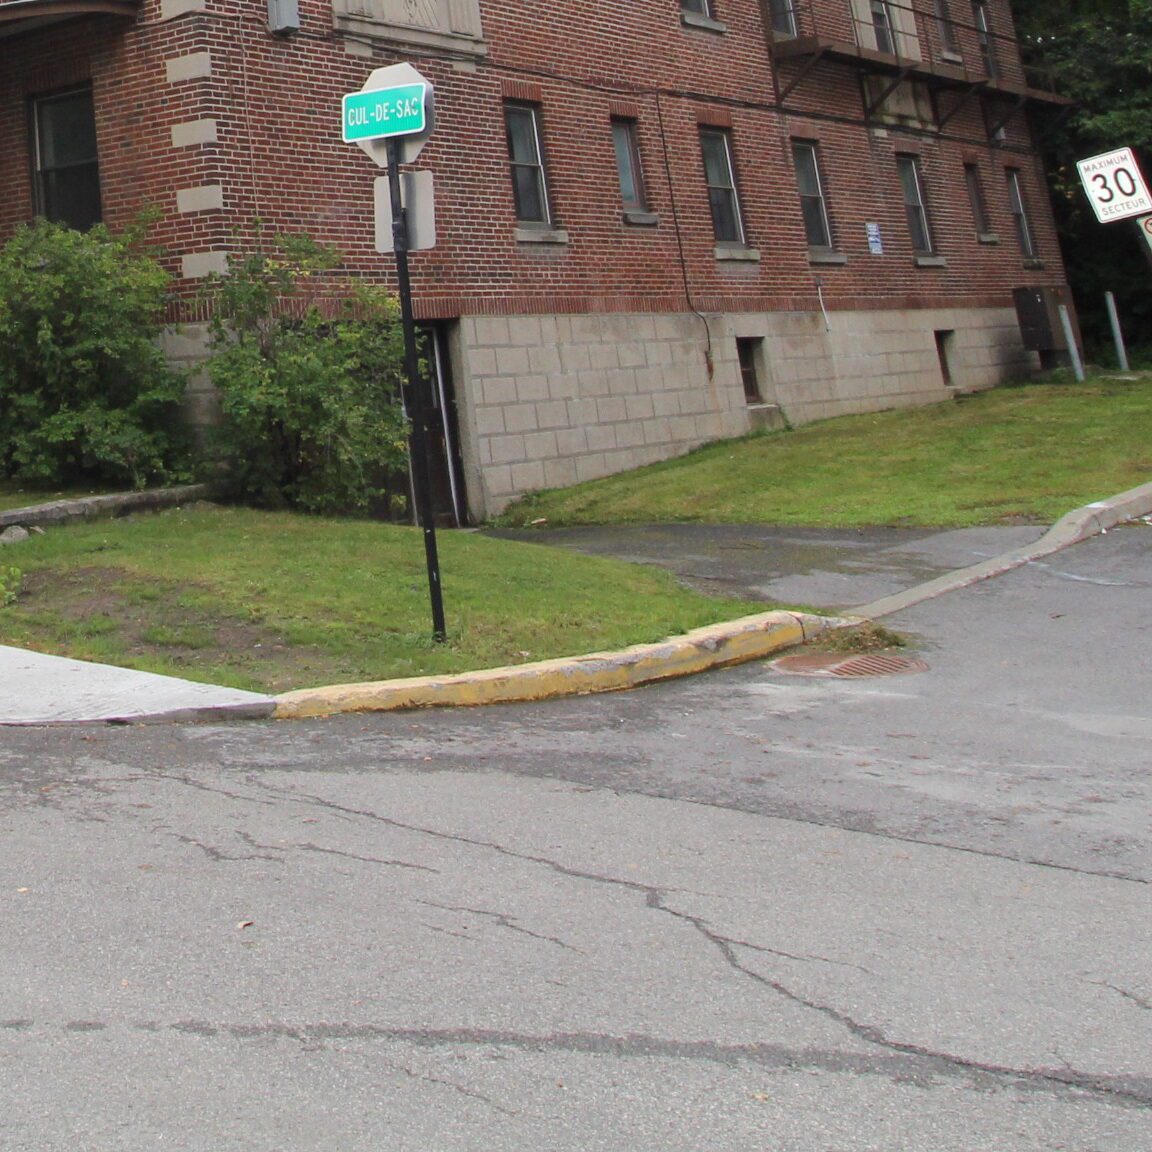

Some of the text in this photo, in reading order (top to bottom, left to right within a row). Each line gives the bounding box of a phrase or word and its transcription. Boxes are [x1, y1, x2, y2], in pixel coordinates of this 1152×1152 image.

[348, 97, 419, 126] CUL-DE-SAC
[1083, 154, 1128, 173] MAXIMUM
[1092, 168, 1136, 203] 30
[1102, 198, 1146, 216] SECTEUR
